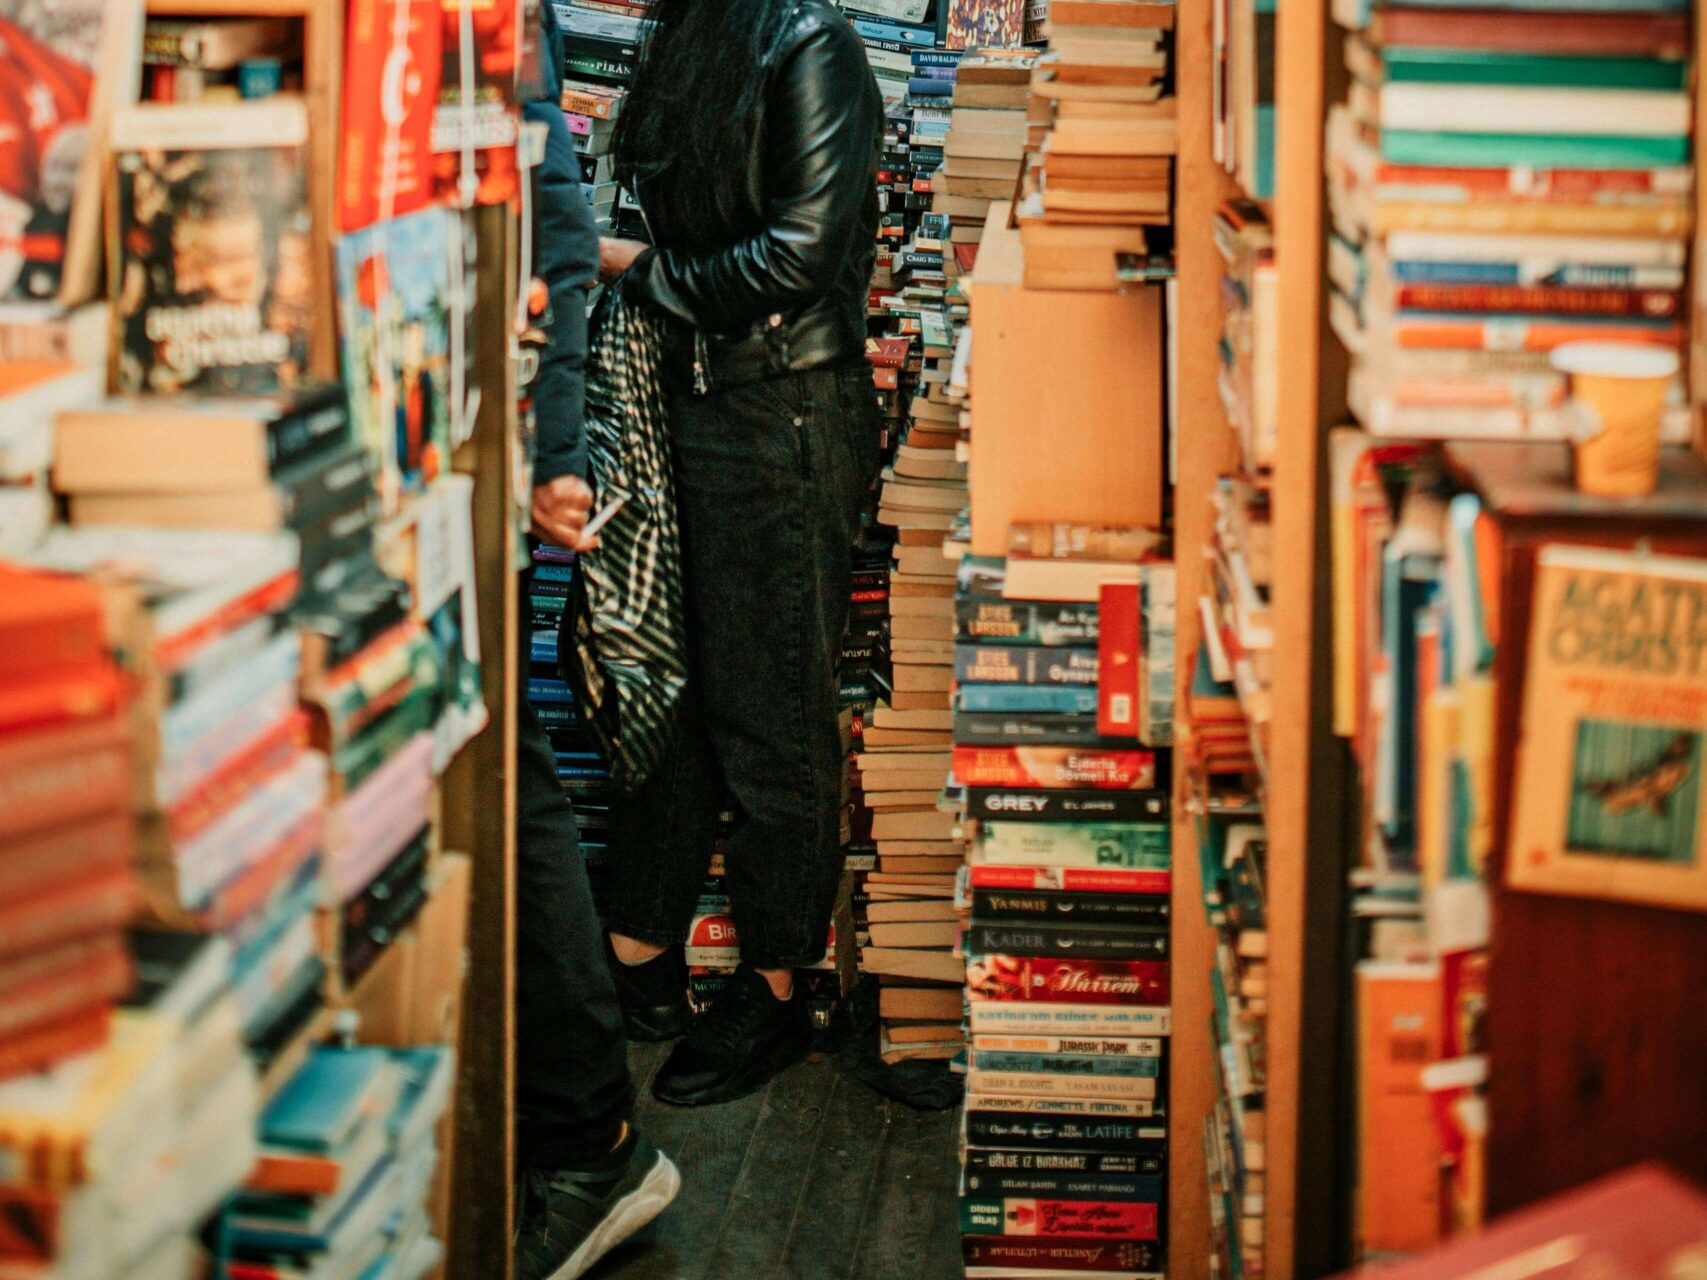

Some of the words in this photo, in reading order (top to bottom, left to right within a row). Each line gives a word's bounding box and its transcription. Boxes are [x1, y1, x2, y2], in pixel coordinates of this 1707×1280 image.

[919, 54, 938, 62] DAVID
[938, 54, 962, 64] BALDAC
[906, 254, 927, 263] CRAIG
[927, 255, 943, 264] RUSS
[984, 794, 1050, 811] GREY
[983, 930, 1045, 949] KADER
[1101, 1040, 1129, 1056] PARK
[977, 1098, 1025, 1109] ANDREWS
[1086, 1124, 1133, 1139] LATİFE
[988, 1153, 1019, 1168] GÖLGE
[970, 1204, 1000, 1214] DİDEM
